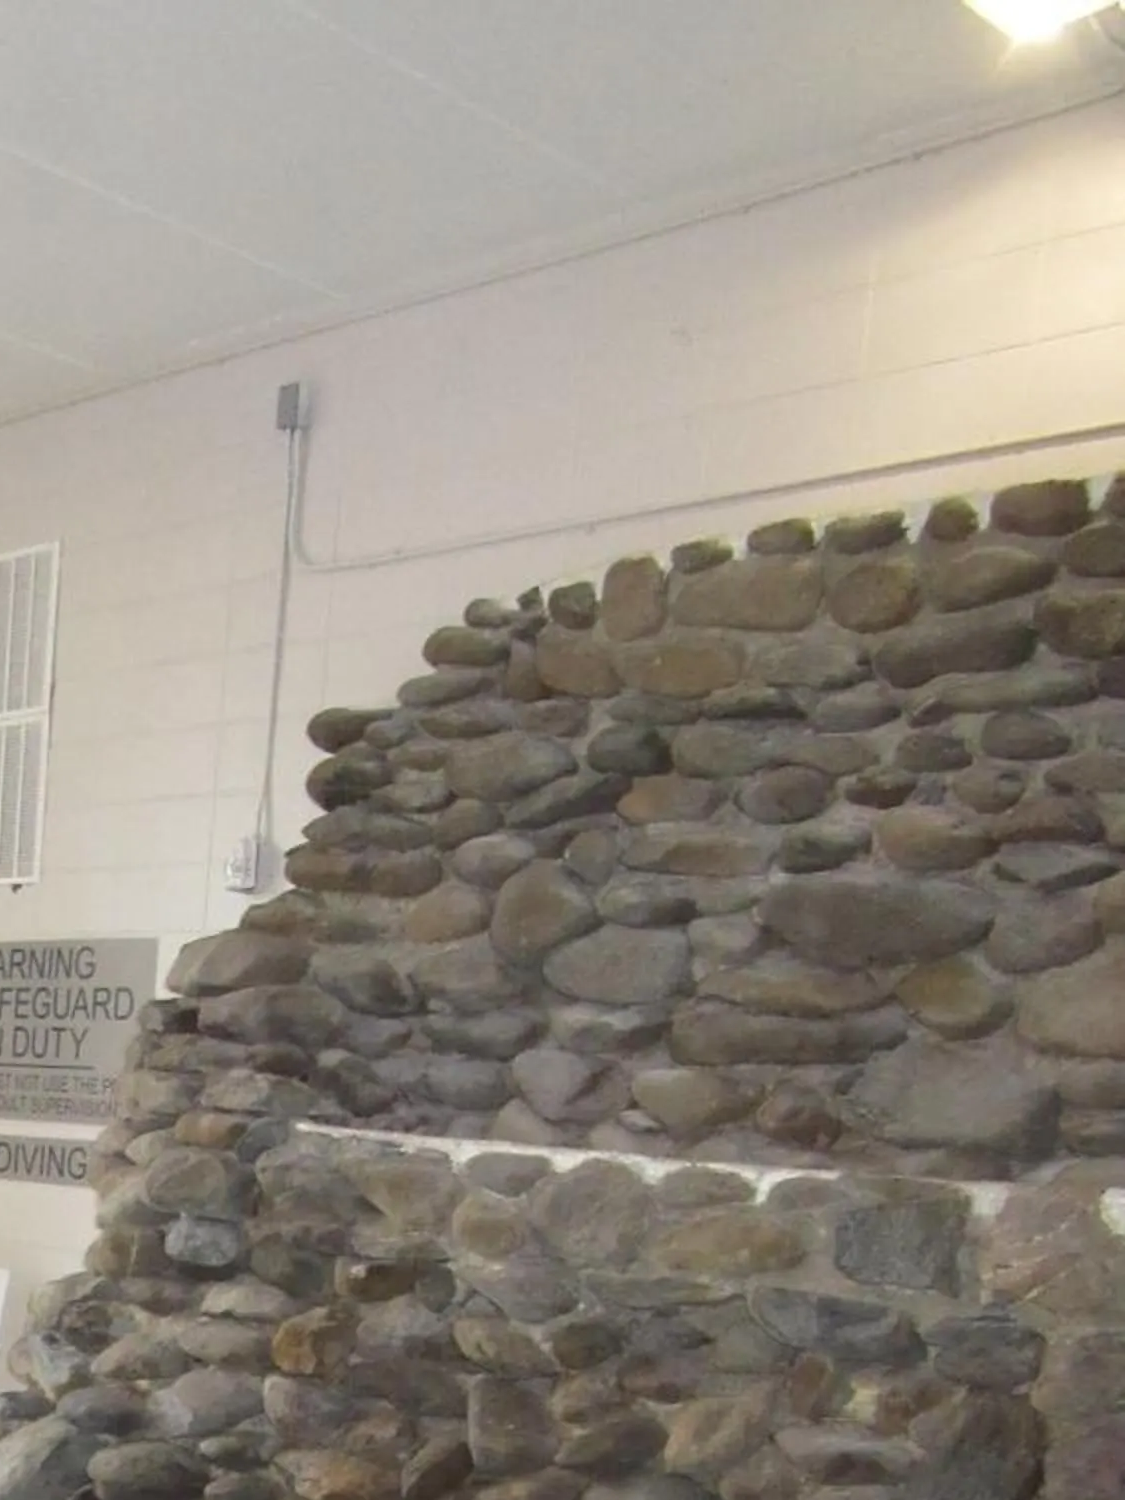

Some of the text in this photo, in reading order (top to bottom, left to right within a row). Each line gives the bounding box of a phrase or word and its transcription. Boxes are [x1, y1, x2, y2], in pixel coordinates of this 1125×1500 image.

[12, 1026, 89, 1060] DUTY
[14, 1074, 39, 1093] NOT
[42, 1075, 69, 1094] USE
[72, 1077, 99, 1096] THE
